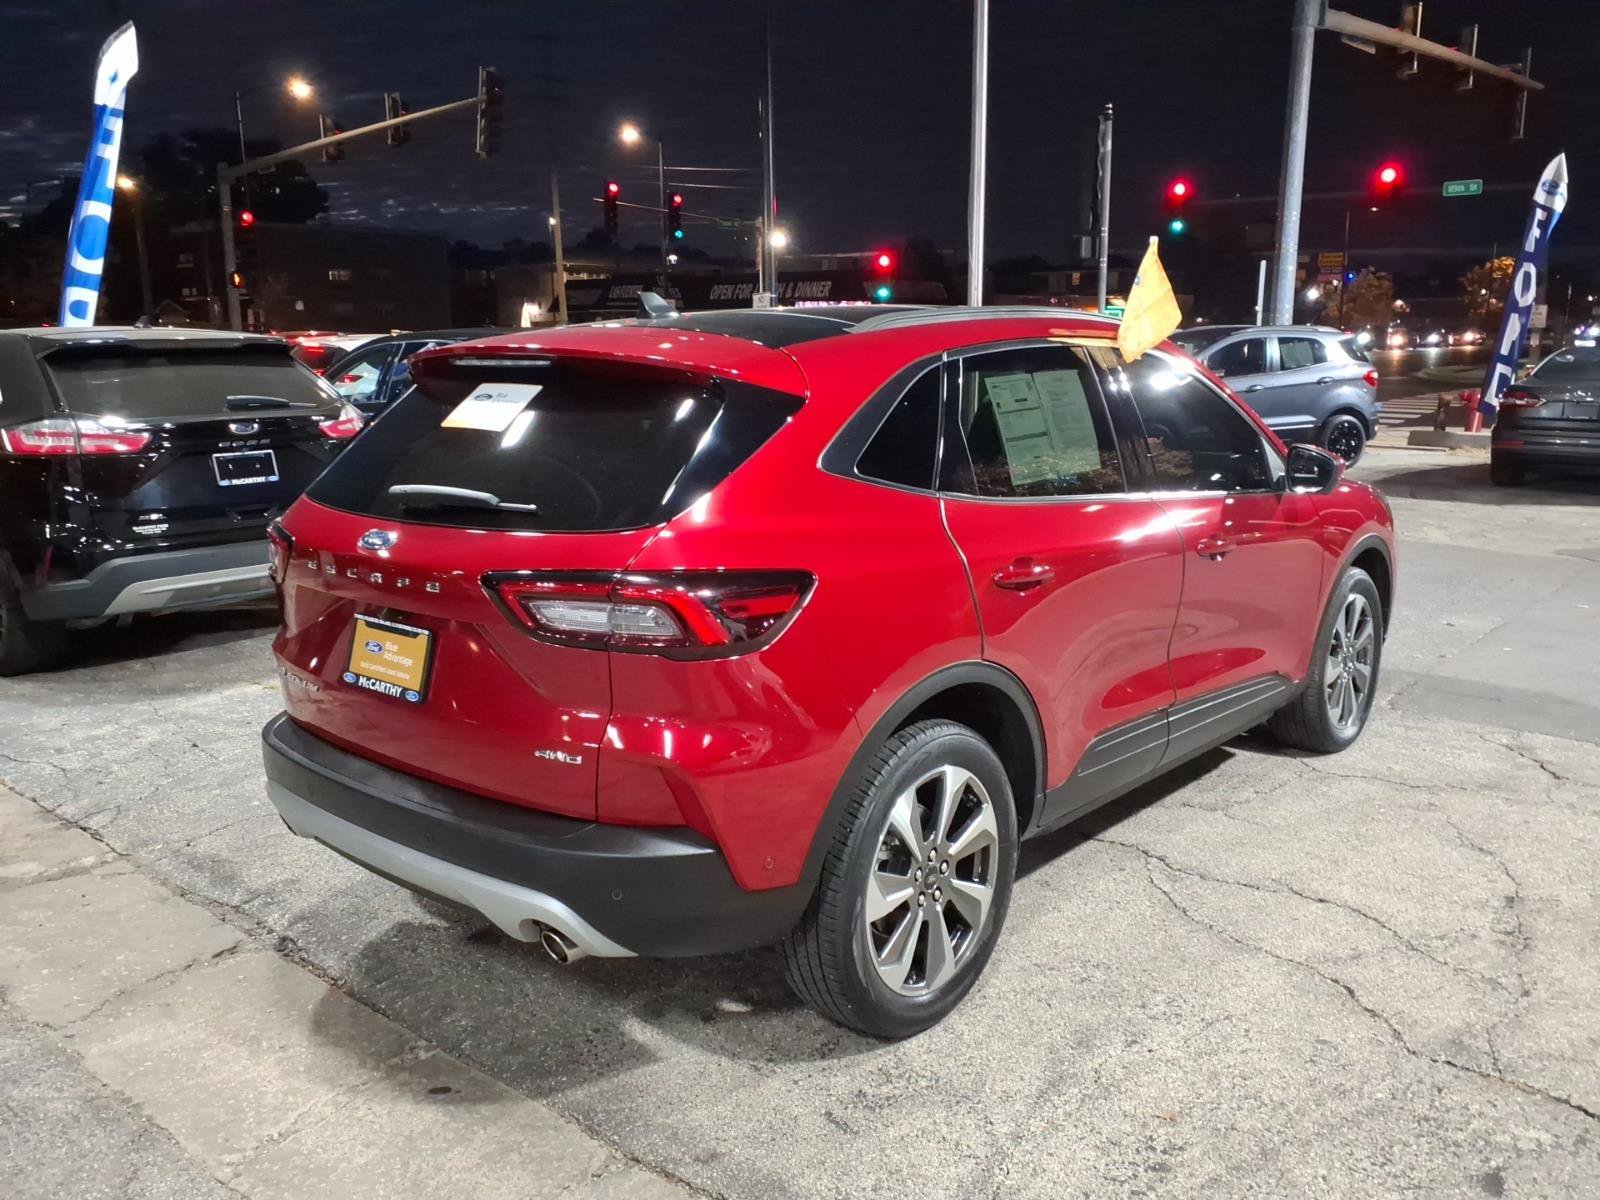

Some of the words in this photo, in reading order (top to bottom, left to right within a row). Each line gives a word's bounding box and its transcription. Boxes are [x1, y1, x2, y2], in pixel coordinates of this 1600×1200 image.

[709, 284, 735, 300] OPEN
[733, 283, 753, 299] FOR
[794, 280, 832, 298] DINNER
[358, 675, 403, 697] McCARTHY
[534, 749, 582, 764] AWD
